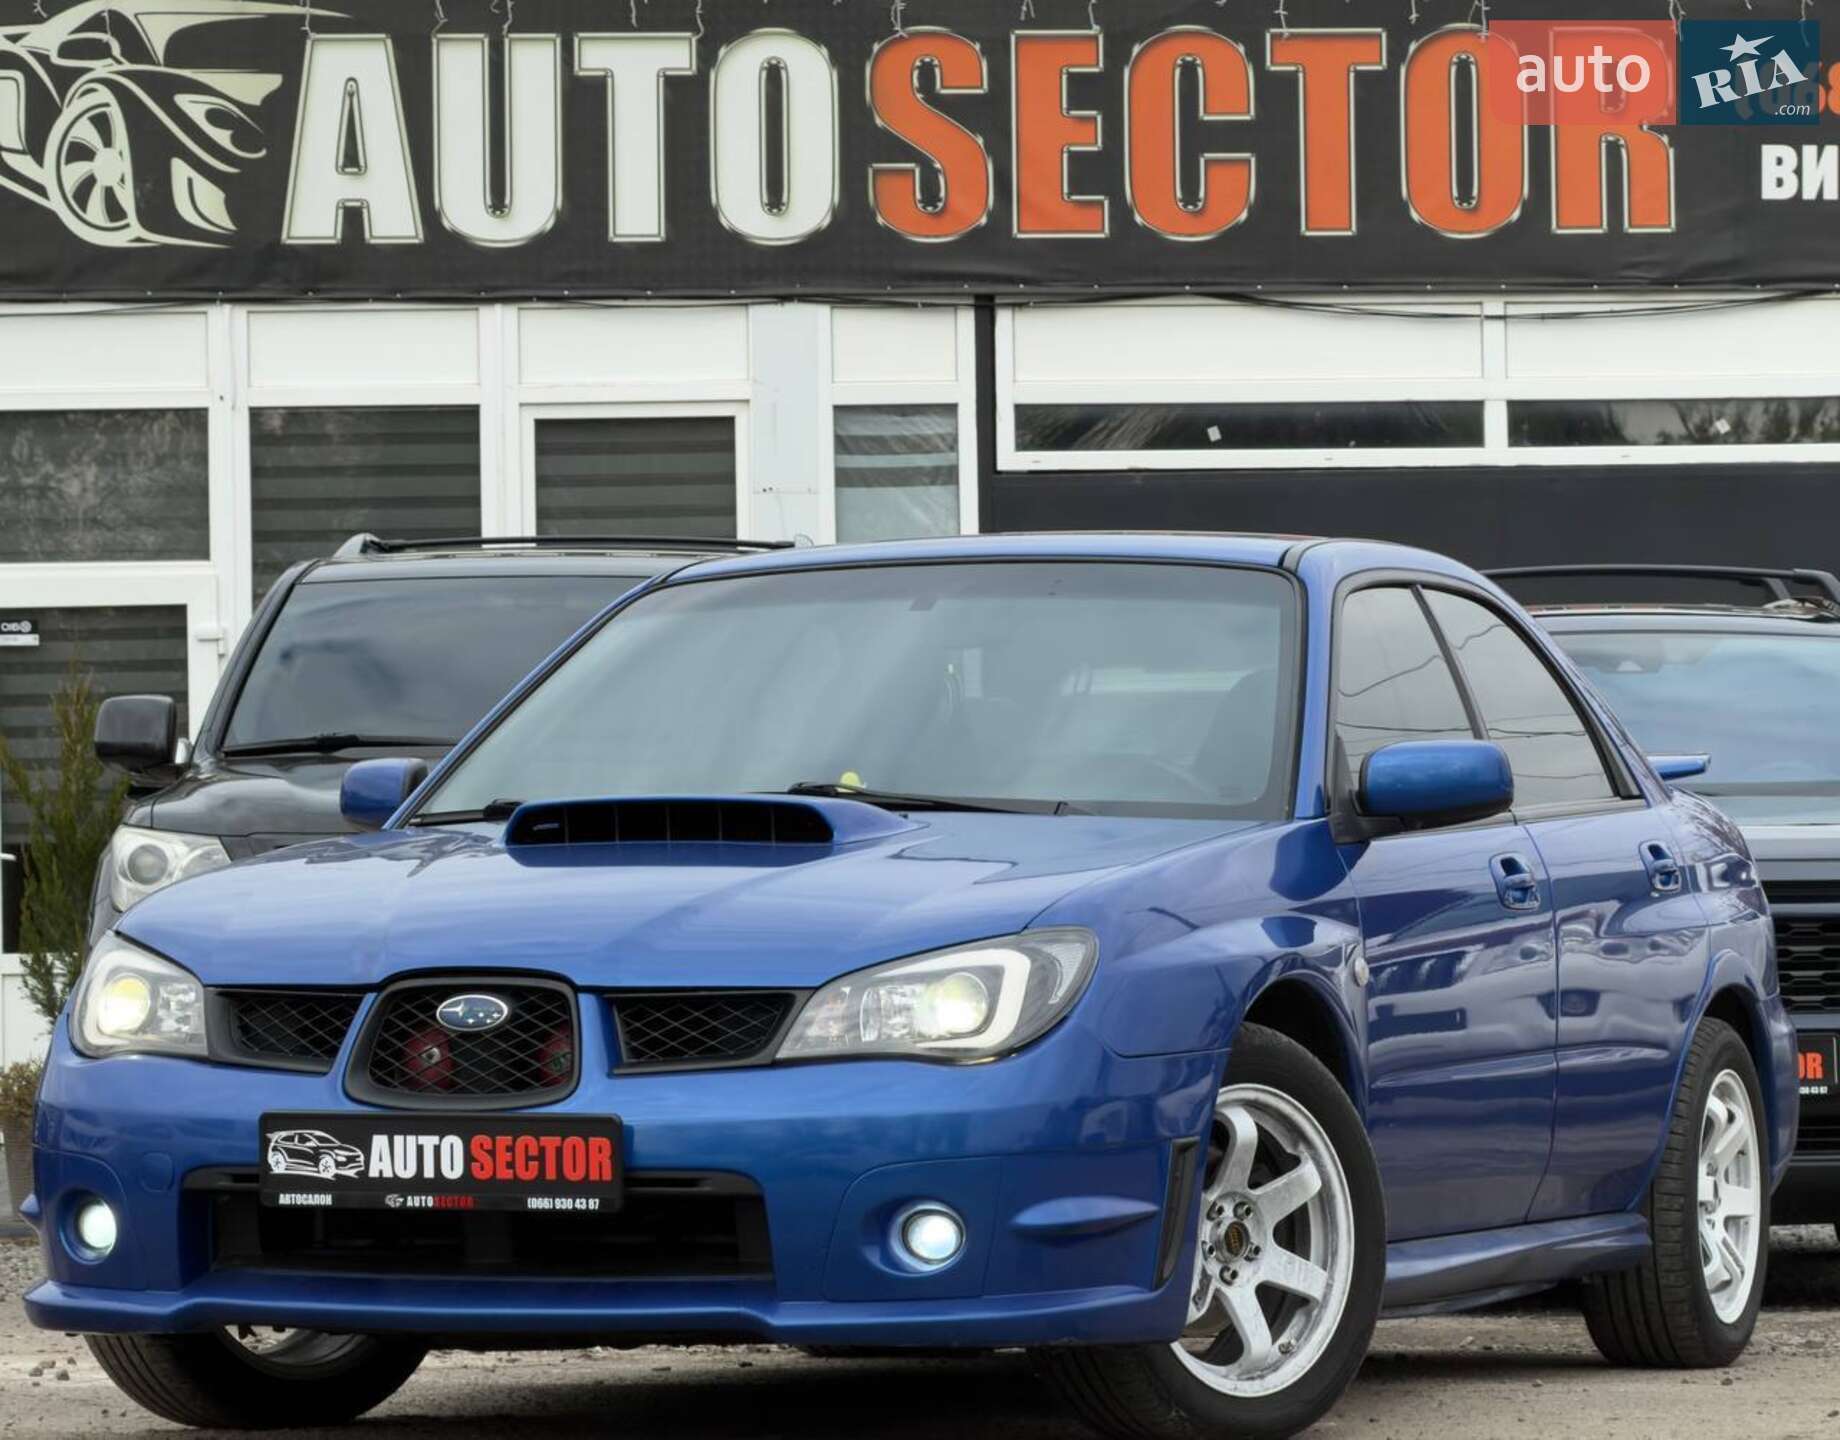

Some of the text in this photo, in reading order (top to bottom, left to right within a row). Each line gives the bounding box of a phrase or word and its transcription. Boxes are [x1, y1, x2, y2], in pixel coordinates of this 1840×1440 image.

[281, 25, 1677, 246] AUTO SECTOR
[368, 1134, 613, 1181] AUTO SECTOR
